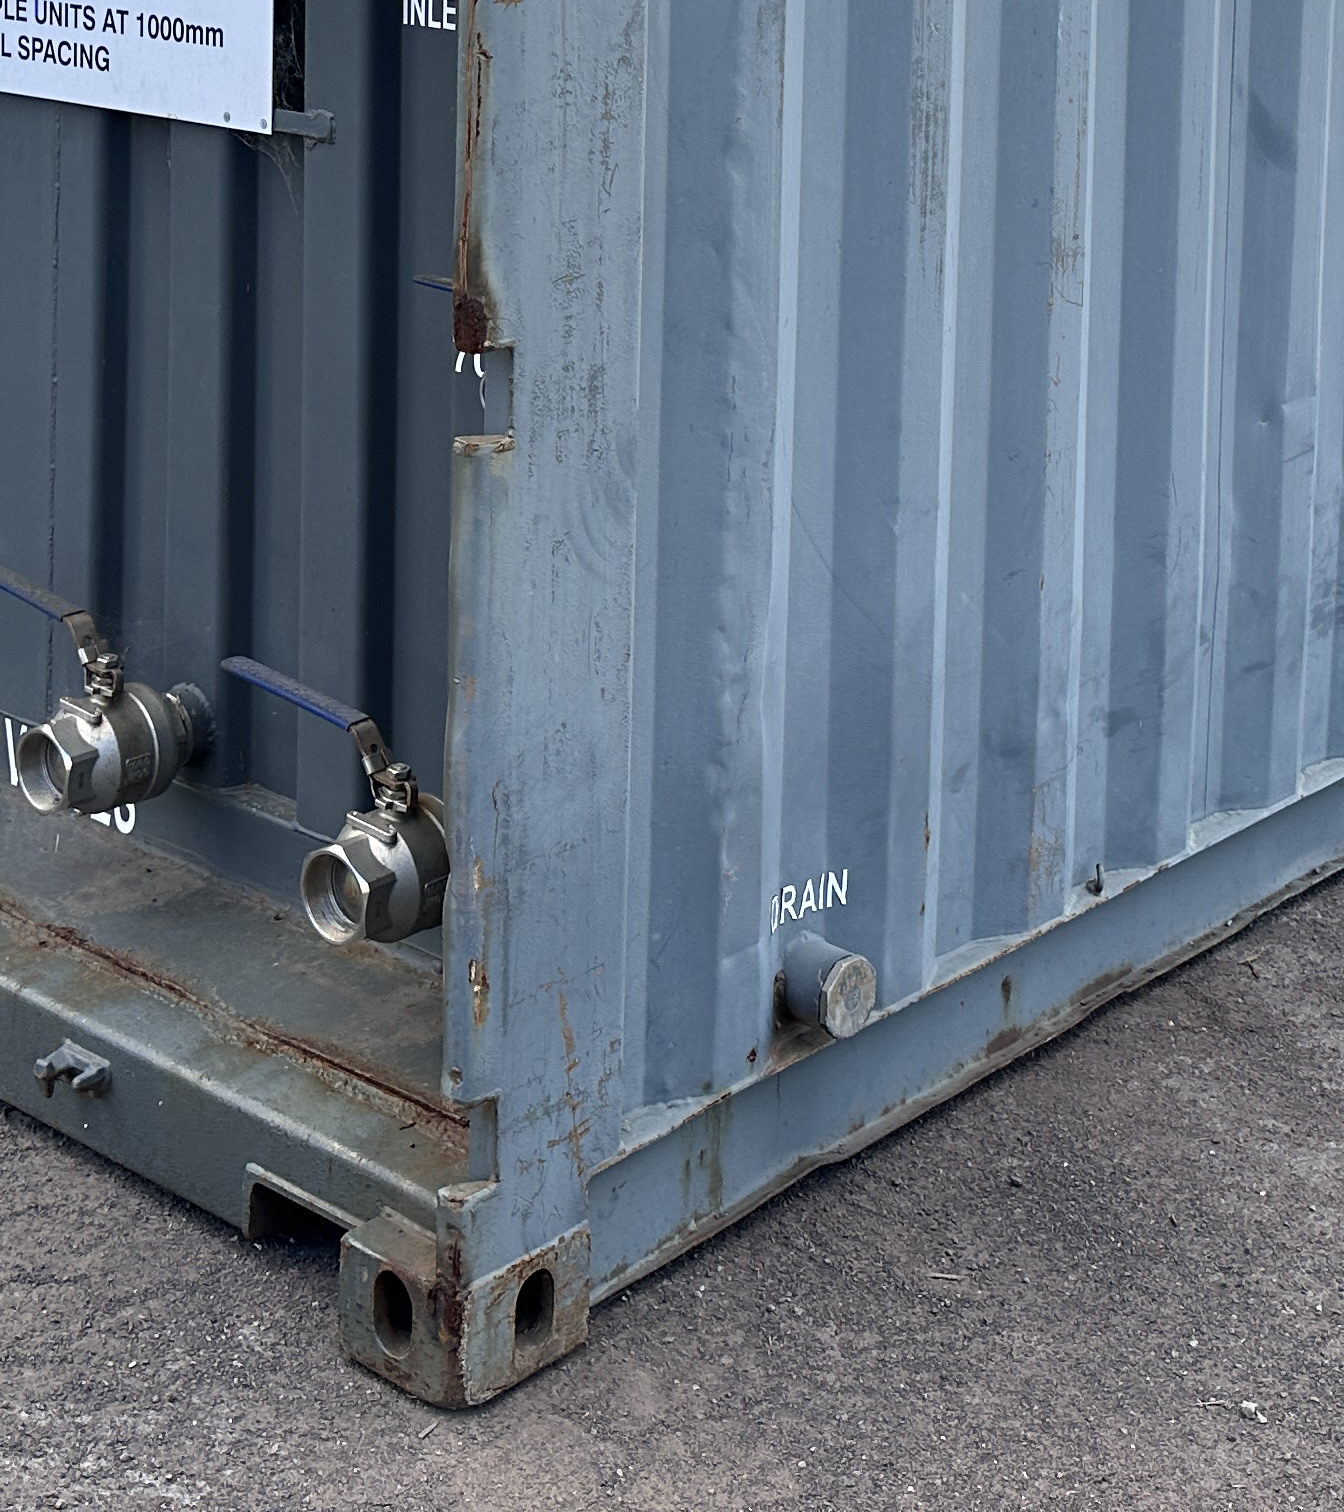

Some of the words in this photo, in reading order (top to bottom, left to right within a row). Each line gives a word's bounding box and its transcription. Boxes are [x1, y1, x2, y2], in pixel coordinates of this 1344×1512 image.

[35, 0, 95, 30] UNITS
[103, 9, 128, 34] AT
[137, 13, 223, 47] 1000mm
[18, 36, 109, 71] SPACING
[771, 869, 847, 933] DRAIN
